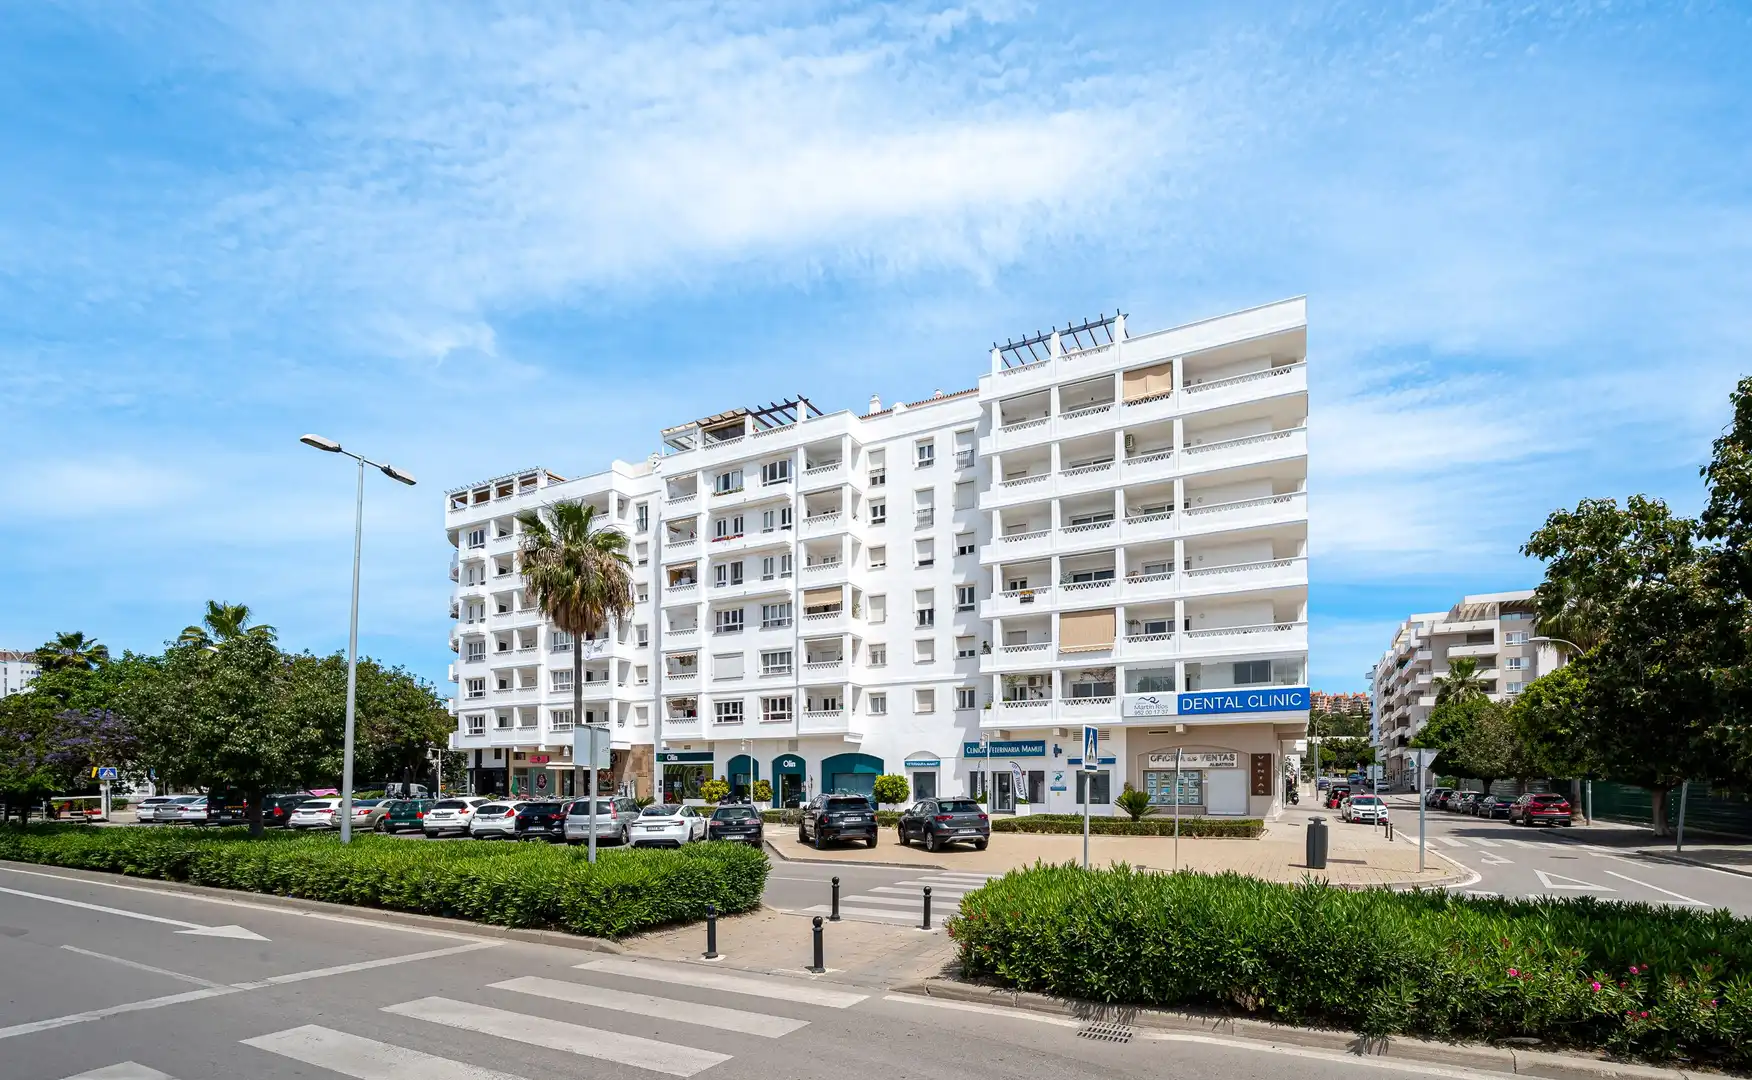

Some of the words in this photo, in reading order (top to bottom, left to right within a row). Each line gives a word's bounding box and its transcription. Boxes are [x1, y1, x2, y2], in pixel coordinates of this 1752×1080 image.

[1182, 696, 1243, 710] DENTAL
[1247, 693, 1302, 708] CLINIC
[1021, 744, 1043, 753] MAMUT
[666, 753, 678, 761] Olin
[1200, 753, 1235, 762] VENTAS
[783, 760, 796, 768] Olin
